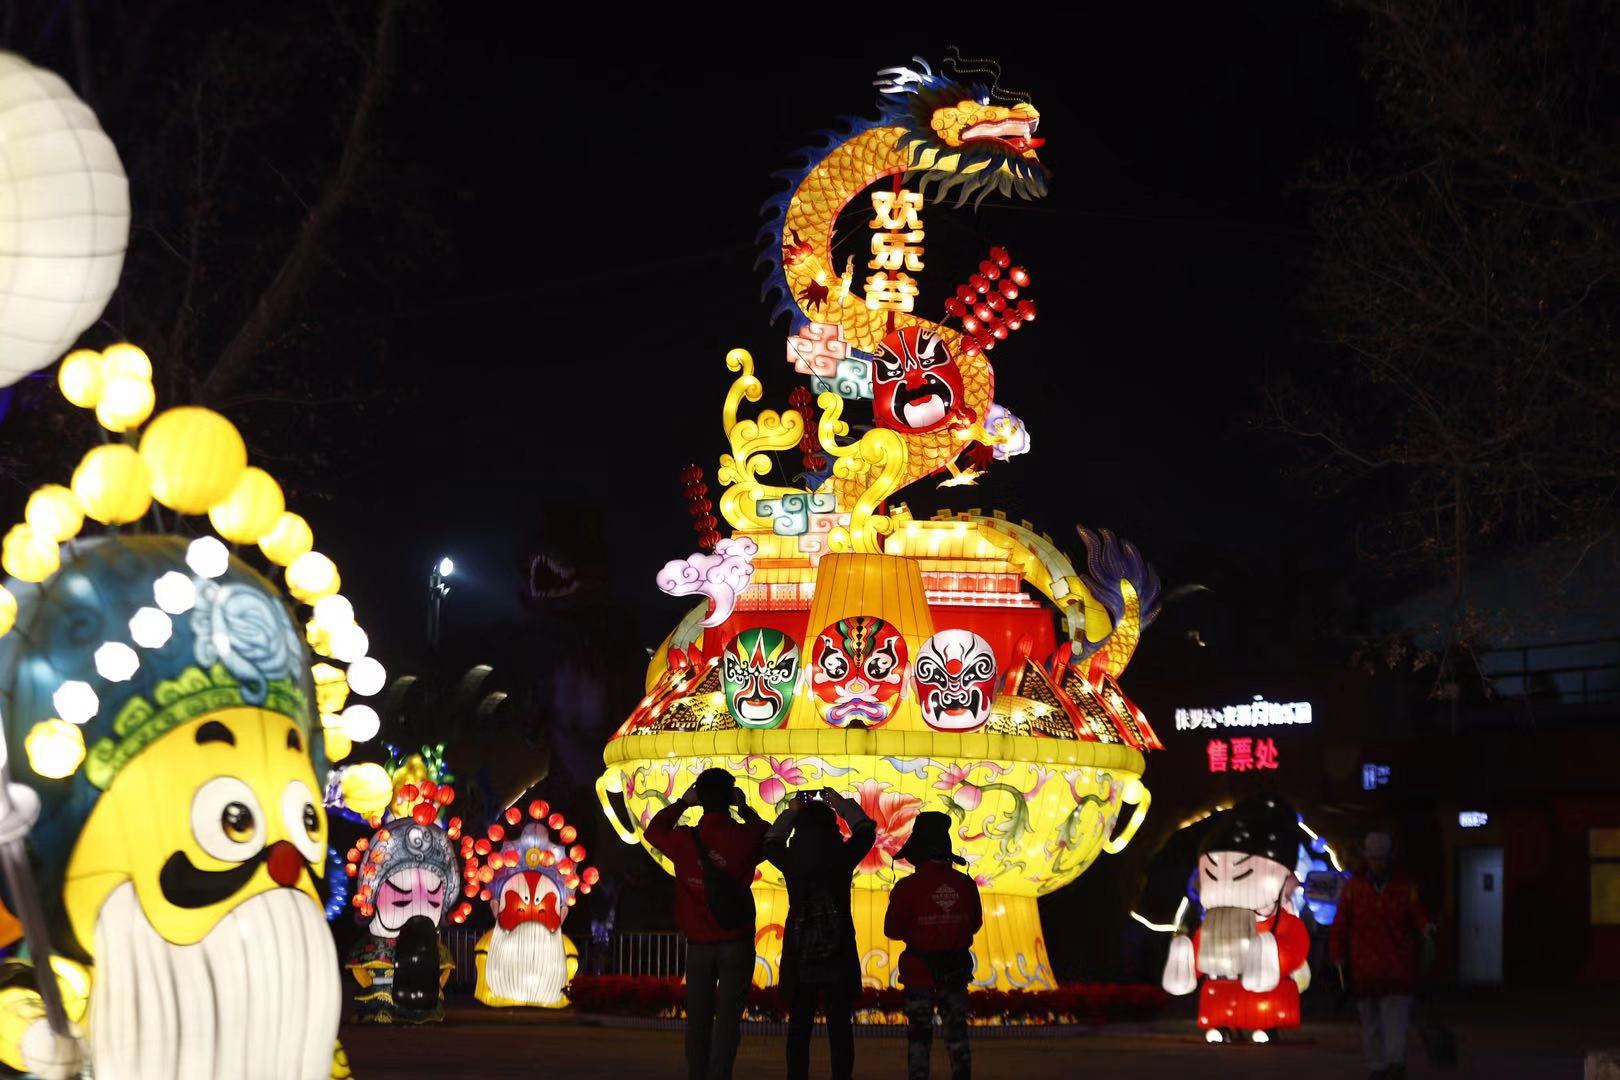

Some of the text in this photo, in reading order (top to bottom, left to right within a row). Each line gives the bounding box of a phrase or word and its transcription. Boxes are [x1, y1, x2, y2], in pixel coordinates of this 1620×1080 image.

[863, 189, 925, 312] 欢乐谷
[1206, 737, 1279, 772] 售票处
